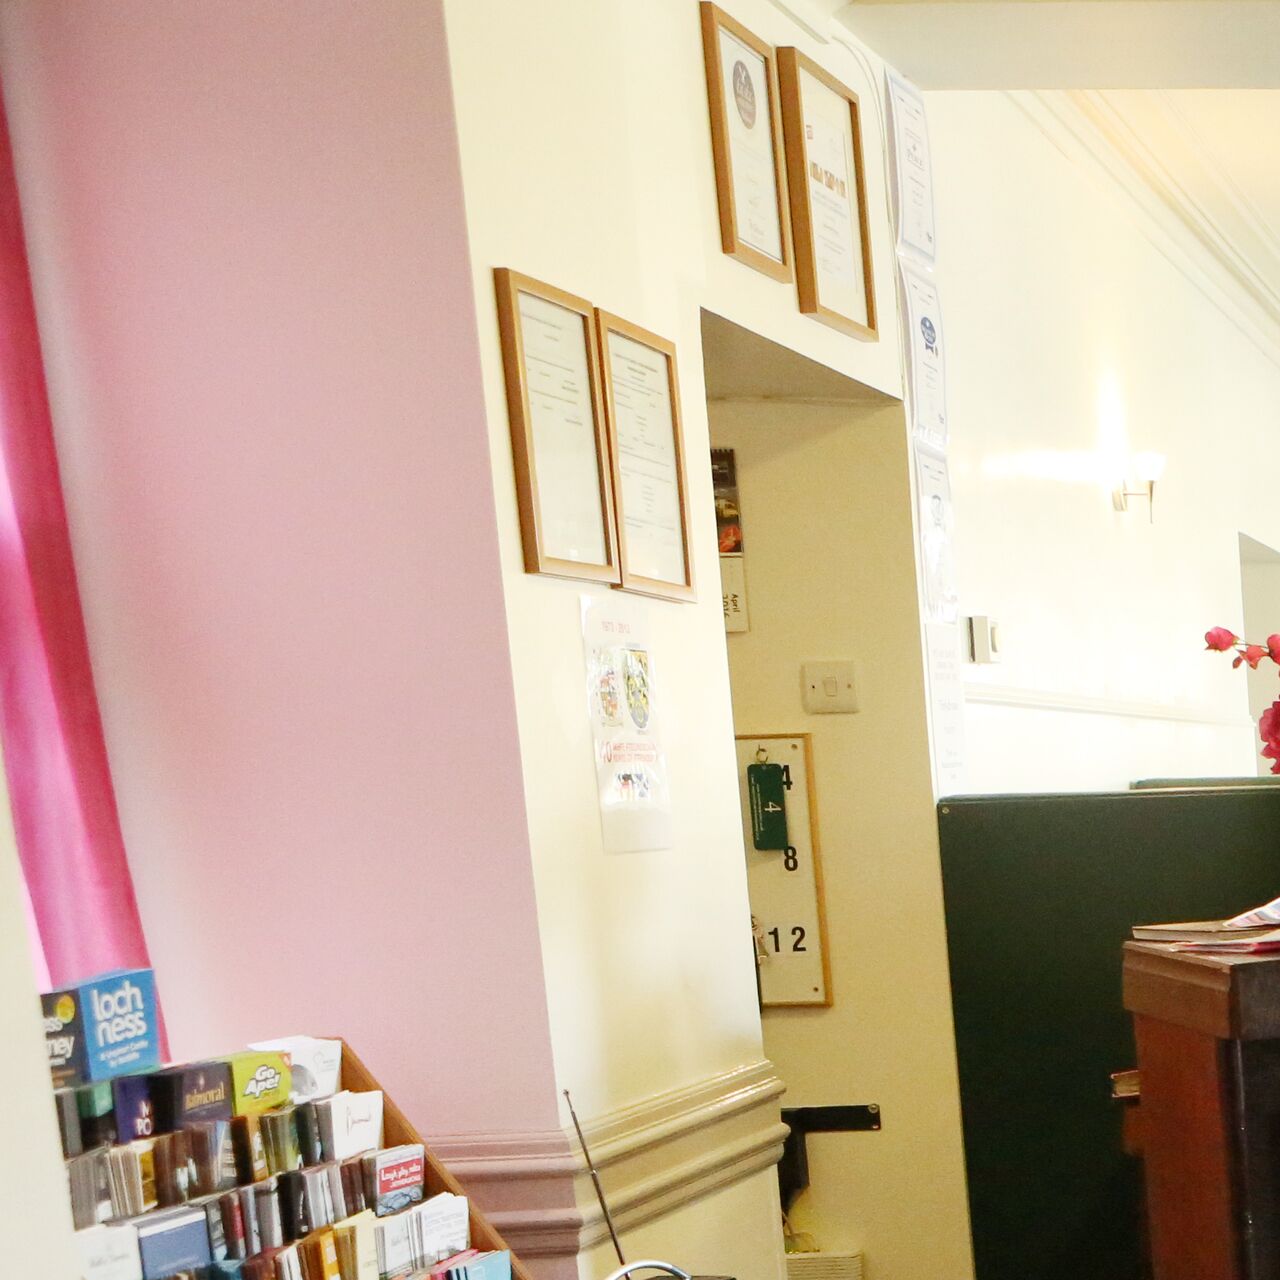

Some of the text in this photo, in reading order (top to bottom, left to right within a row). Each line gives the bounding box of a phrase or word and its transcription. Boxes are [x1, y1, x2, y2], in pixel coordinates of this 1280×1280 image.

[731, 593, 741, 613] April
[764, 801, 782, 813] 4
[784, 846, 798, 871] 8
[768, 926, 806, 952] 12
[92, 980, 144, 1021] loch
[97, 1011, 148, 1047] ness
[243, 1072, 281, 1098] Ape!
[255, 1064, 276, 1081] Go
